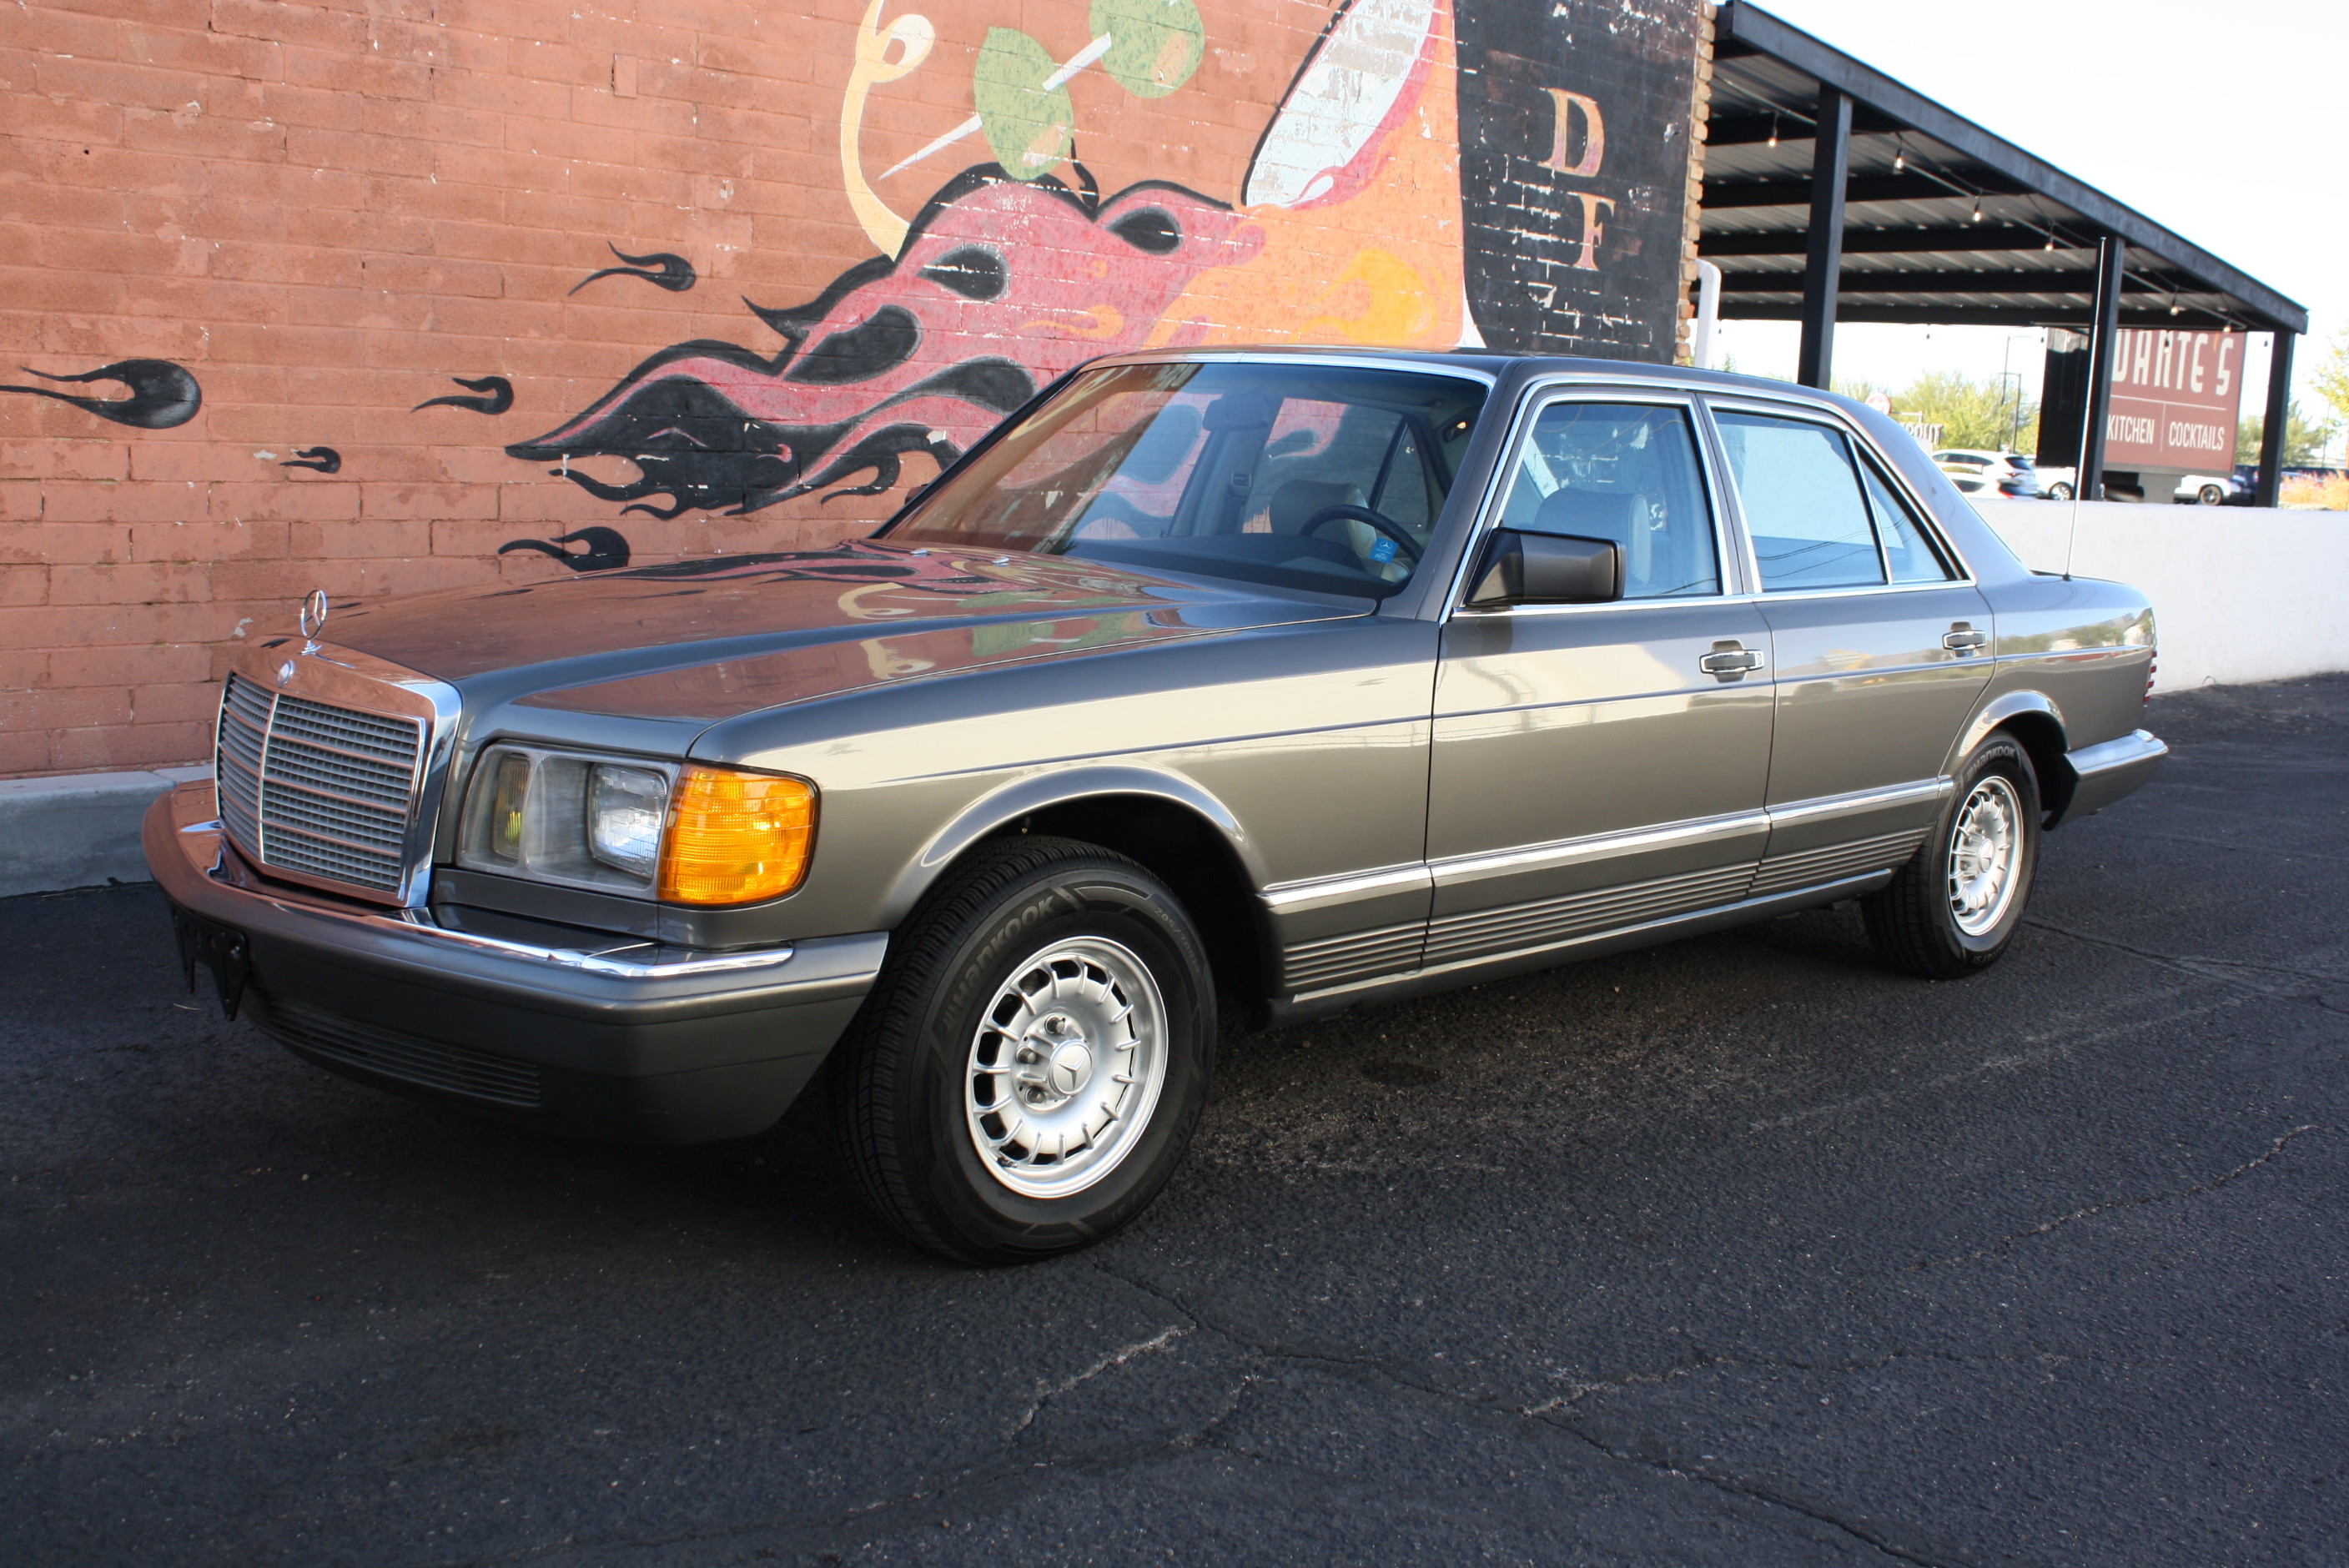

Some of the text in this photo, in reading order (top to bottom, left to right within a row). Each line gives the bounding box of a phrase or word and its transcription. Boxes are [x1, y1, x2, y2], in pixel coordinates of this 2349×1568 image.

[1537, 88, 1605, 178] D
[1572, 193, 1616, 271] F
[2106, 415, 2225, 451] KITCHEN COCKTAILS
